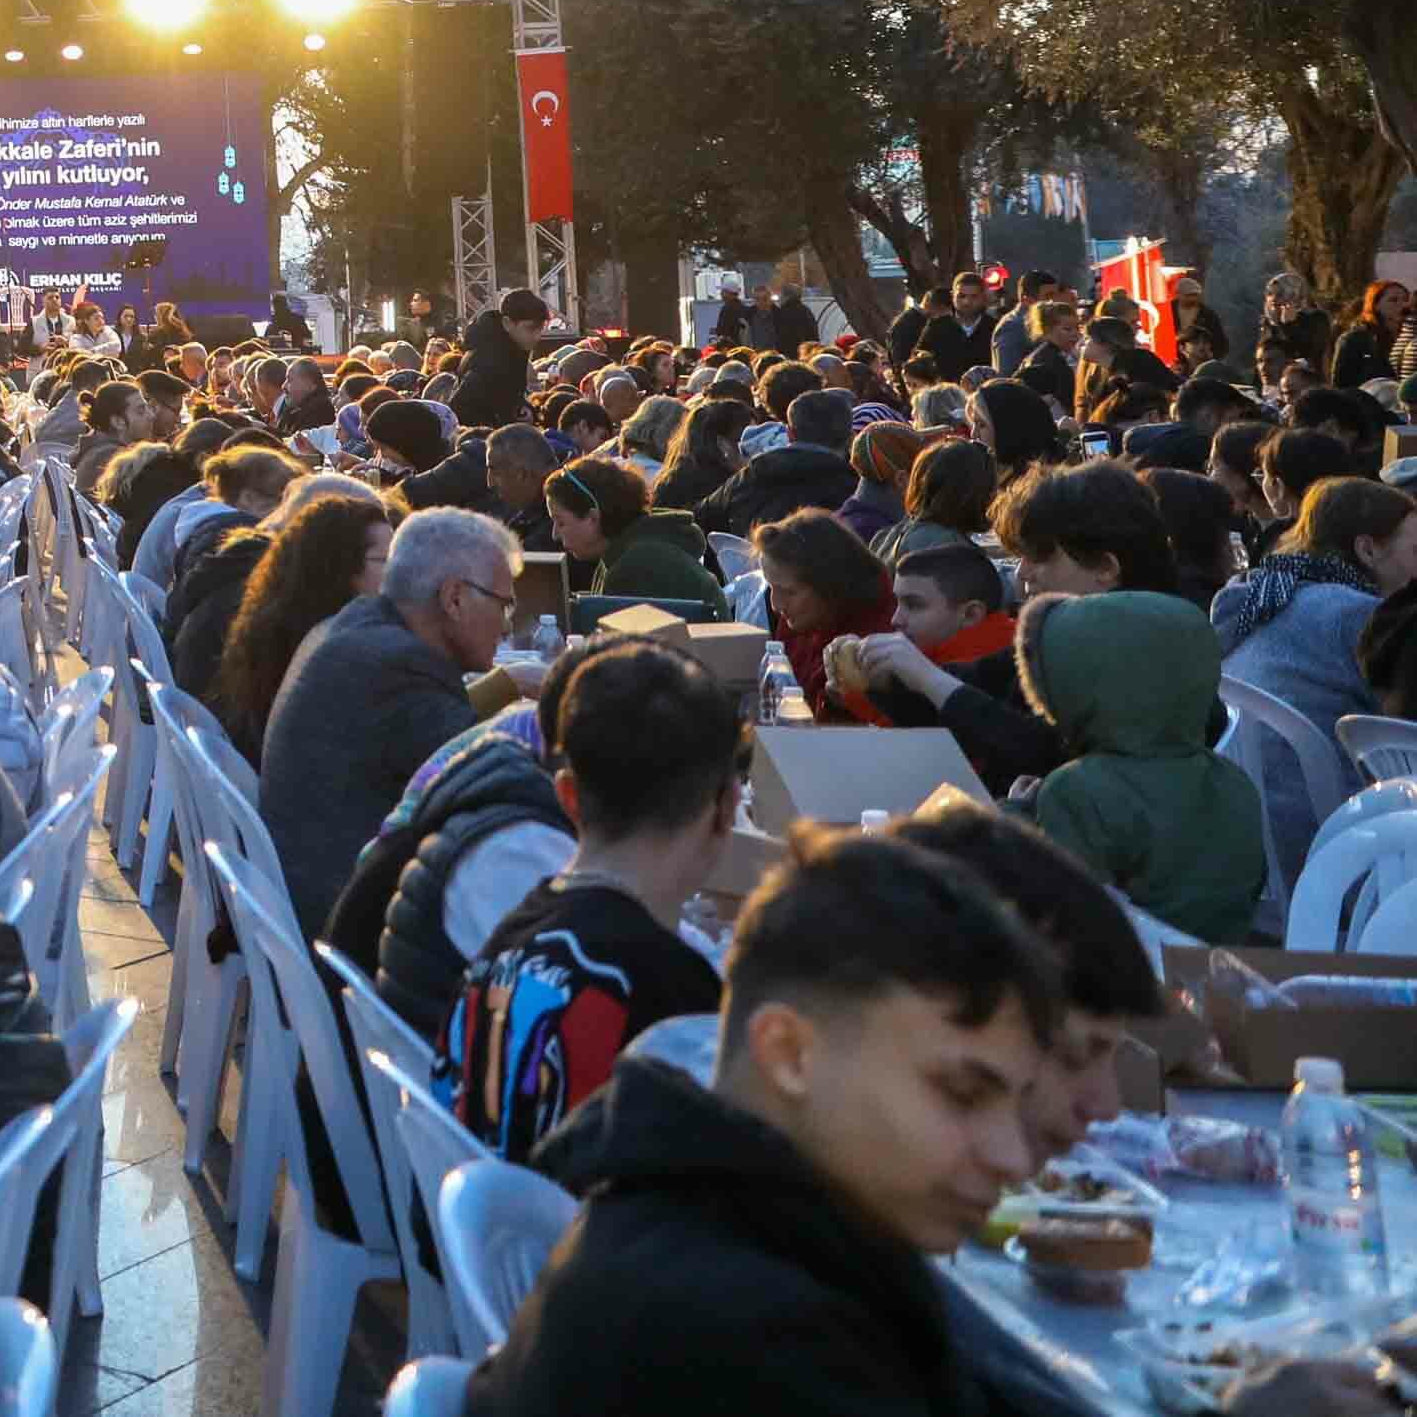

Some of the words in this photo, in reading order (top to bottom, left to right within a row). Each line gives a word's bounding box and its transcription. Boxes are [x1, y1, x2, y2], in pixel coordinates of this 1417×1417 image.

[41, 115, 65, 128] altın
[68, 115, 114, 127] harflerle
[117, 114, 145, 128] yazılı
[59, 138, 160, 159] Zaferi'nin
[2, 165, 50, 189] yılını
[57, 164, 149, 186] kutluyor,
[34, 197, 82, 210] Mustafa
[84, 195, 122, 208] Kemal
[124, 194, 168, 207] Atatürk
[170, 195, 185, 206] ve
[42, 215, 74, 227] üzere
[77, 214, 101, 227] tüm
[103, 214, 127, 225] aziz
[129, 211, 198, 227] şehitlerimizi
[8, 236, 39, 249] saygı
[42, 236, 56, 246] ve
[58, 234, 108, 246] minnetle
[29, 274, 81, 287] ERHAN
[84, 273, 122, 287] KILIÇ
